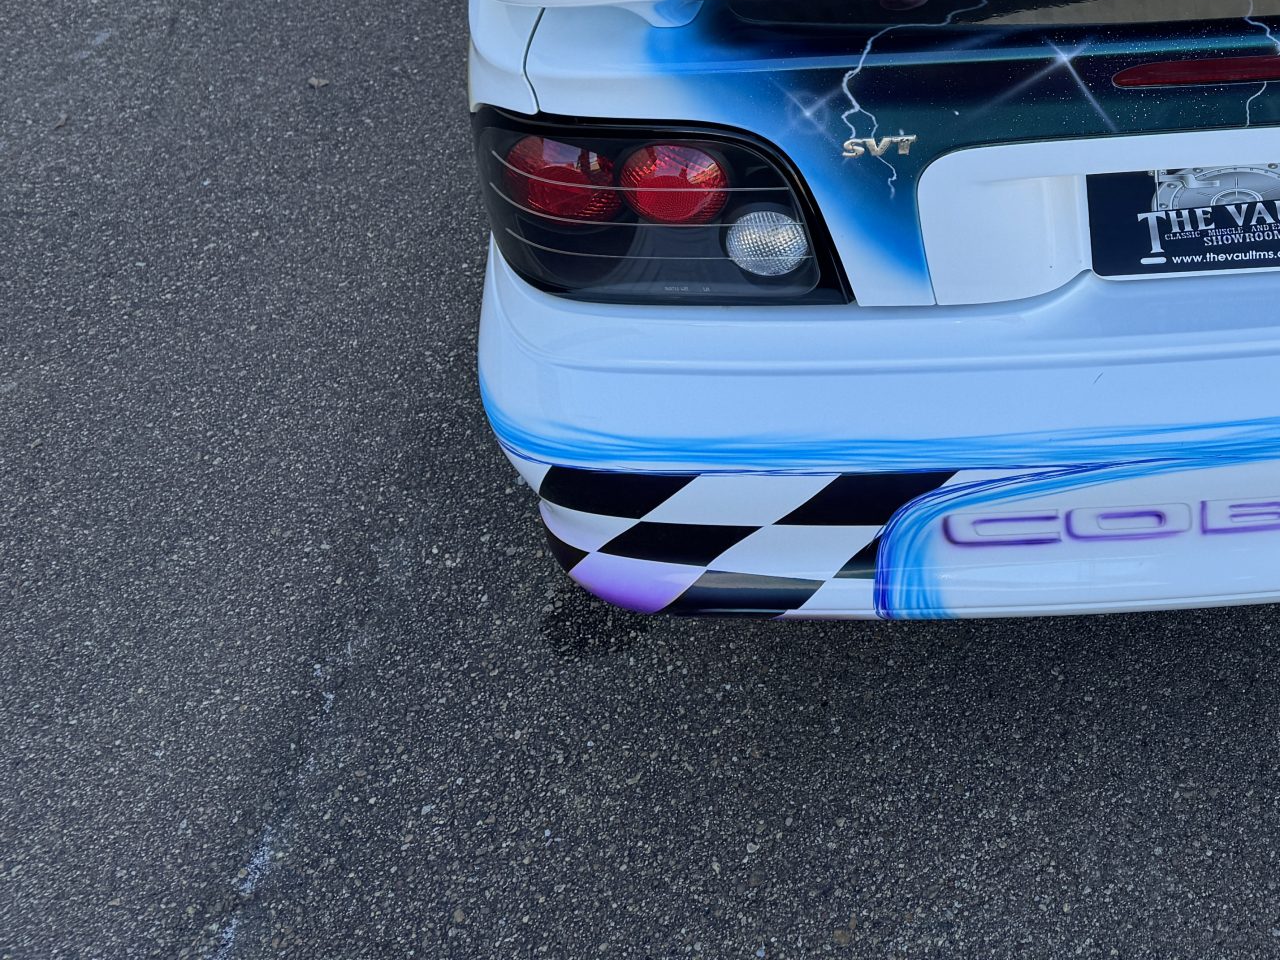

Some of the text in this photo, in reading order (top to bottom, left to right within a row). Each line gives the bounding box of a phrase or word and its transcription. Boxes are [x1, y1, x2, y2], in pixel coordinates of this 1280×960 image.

[842, 134, 917, 158] SVT
[1137, 206, 1215, 254] THE
[1164, 230, 1201, 241] CLASSIC
[1208, 226, 1244, 237] MUSCLE
[1251, 223, 1270, 232] AND
